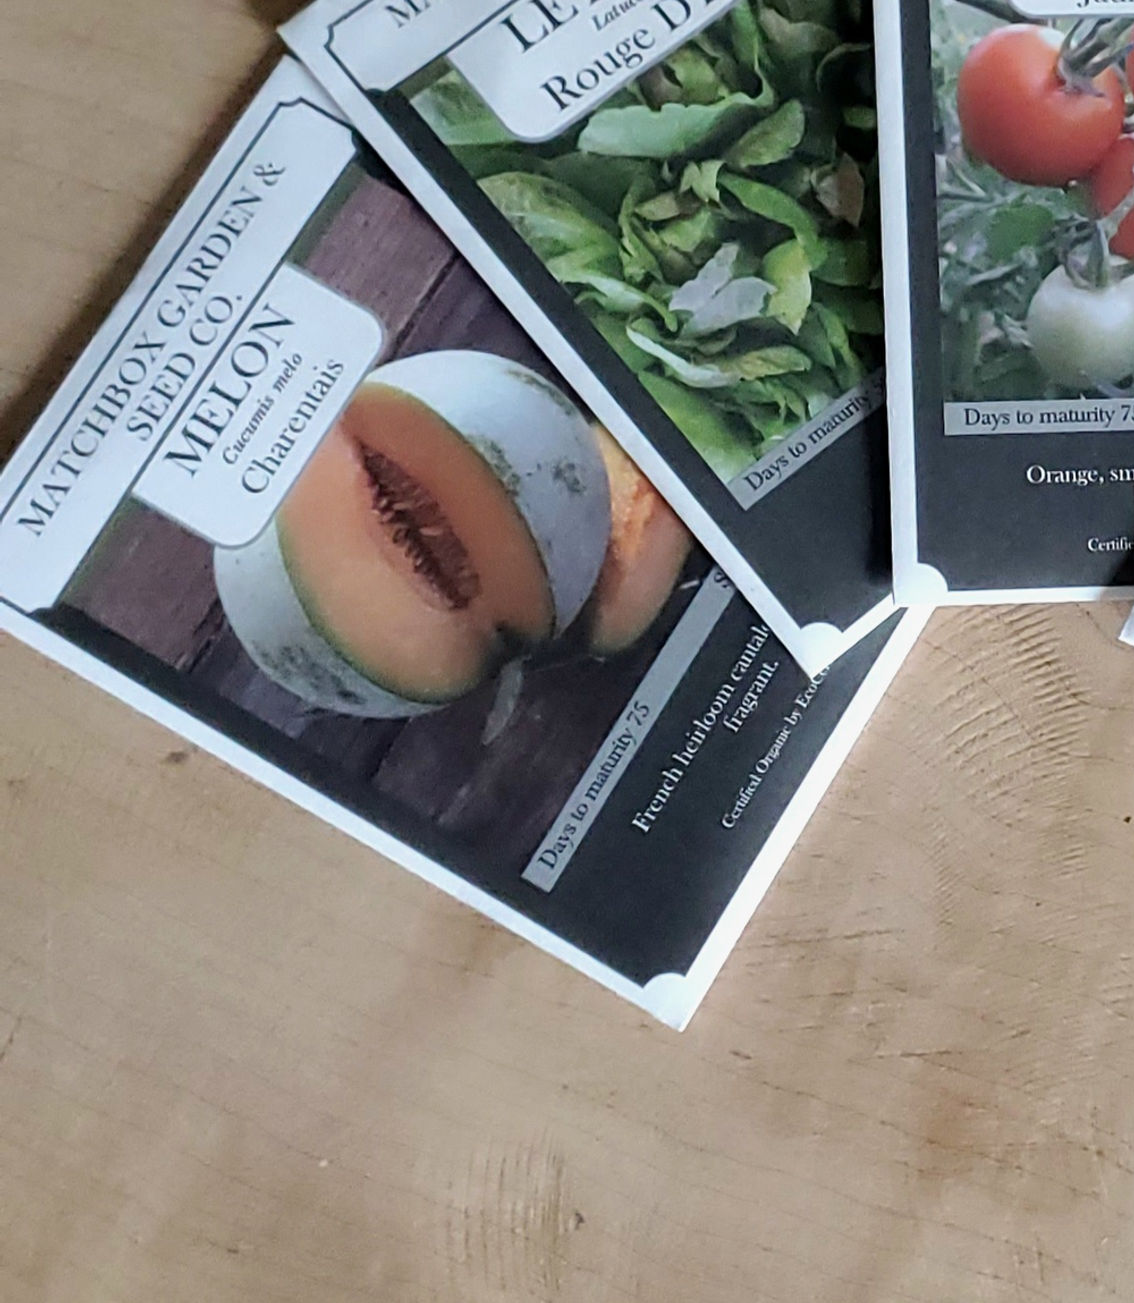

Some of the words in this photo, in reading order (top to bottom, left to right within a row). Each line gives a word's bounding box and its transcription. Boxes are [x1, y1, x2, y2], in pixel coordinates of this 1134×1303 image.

[540, 26, 656, 112] Rouge
[17, 332, 165, 537] MATCHBOX
[157, 187, 263, 328] GARDEN
[253, 161, 286, 187] &
[126, 351, 196, 442] SEED
[190, 293, 243, 346] CO.
[162, 302, 296, 478] MELON
[222, 393, 277, 466] Cucumis
[273, 352, 303, 395] melo
[241, 358, 345, 494] Charentais
[744, 456, 789, 491] Days
[788, 442, 808, 458] to
[965, 408, 1010, 430] Days
[1016, 408, 1034, 425] to
[1039, 406, 1116, 428] maturity
[1026, 464, 1105, 486] Orange,
[723, 661, 779, 733] fragrant.
[538, 823, 577, 870] Days
[570, 802, 590, 820] to
[584, 729, 638, 804] maturity
[627, 701, 650, 727] 75
[631, 759, 683, 833] French
[672, 688, 733, 768] heirloom
[721, 775, 762, 829] Certified
[756, 727, 792, 774] Organic
[784, 708, 804, 727] by
